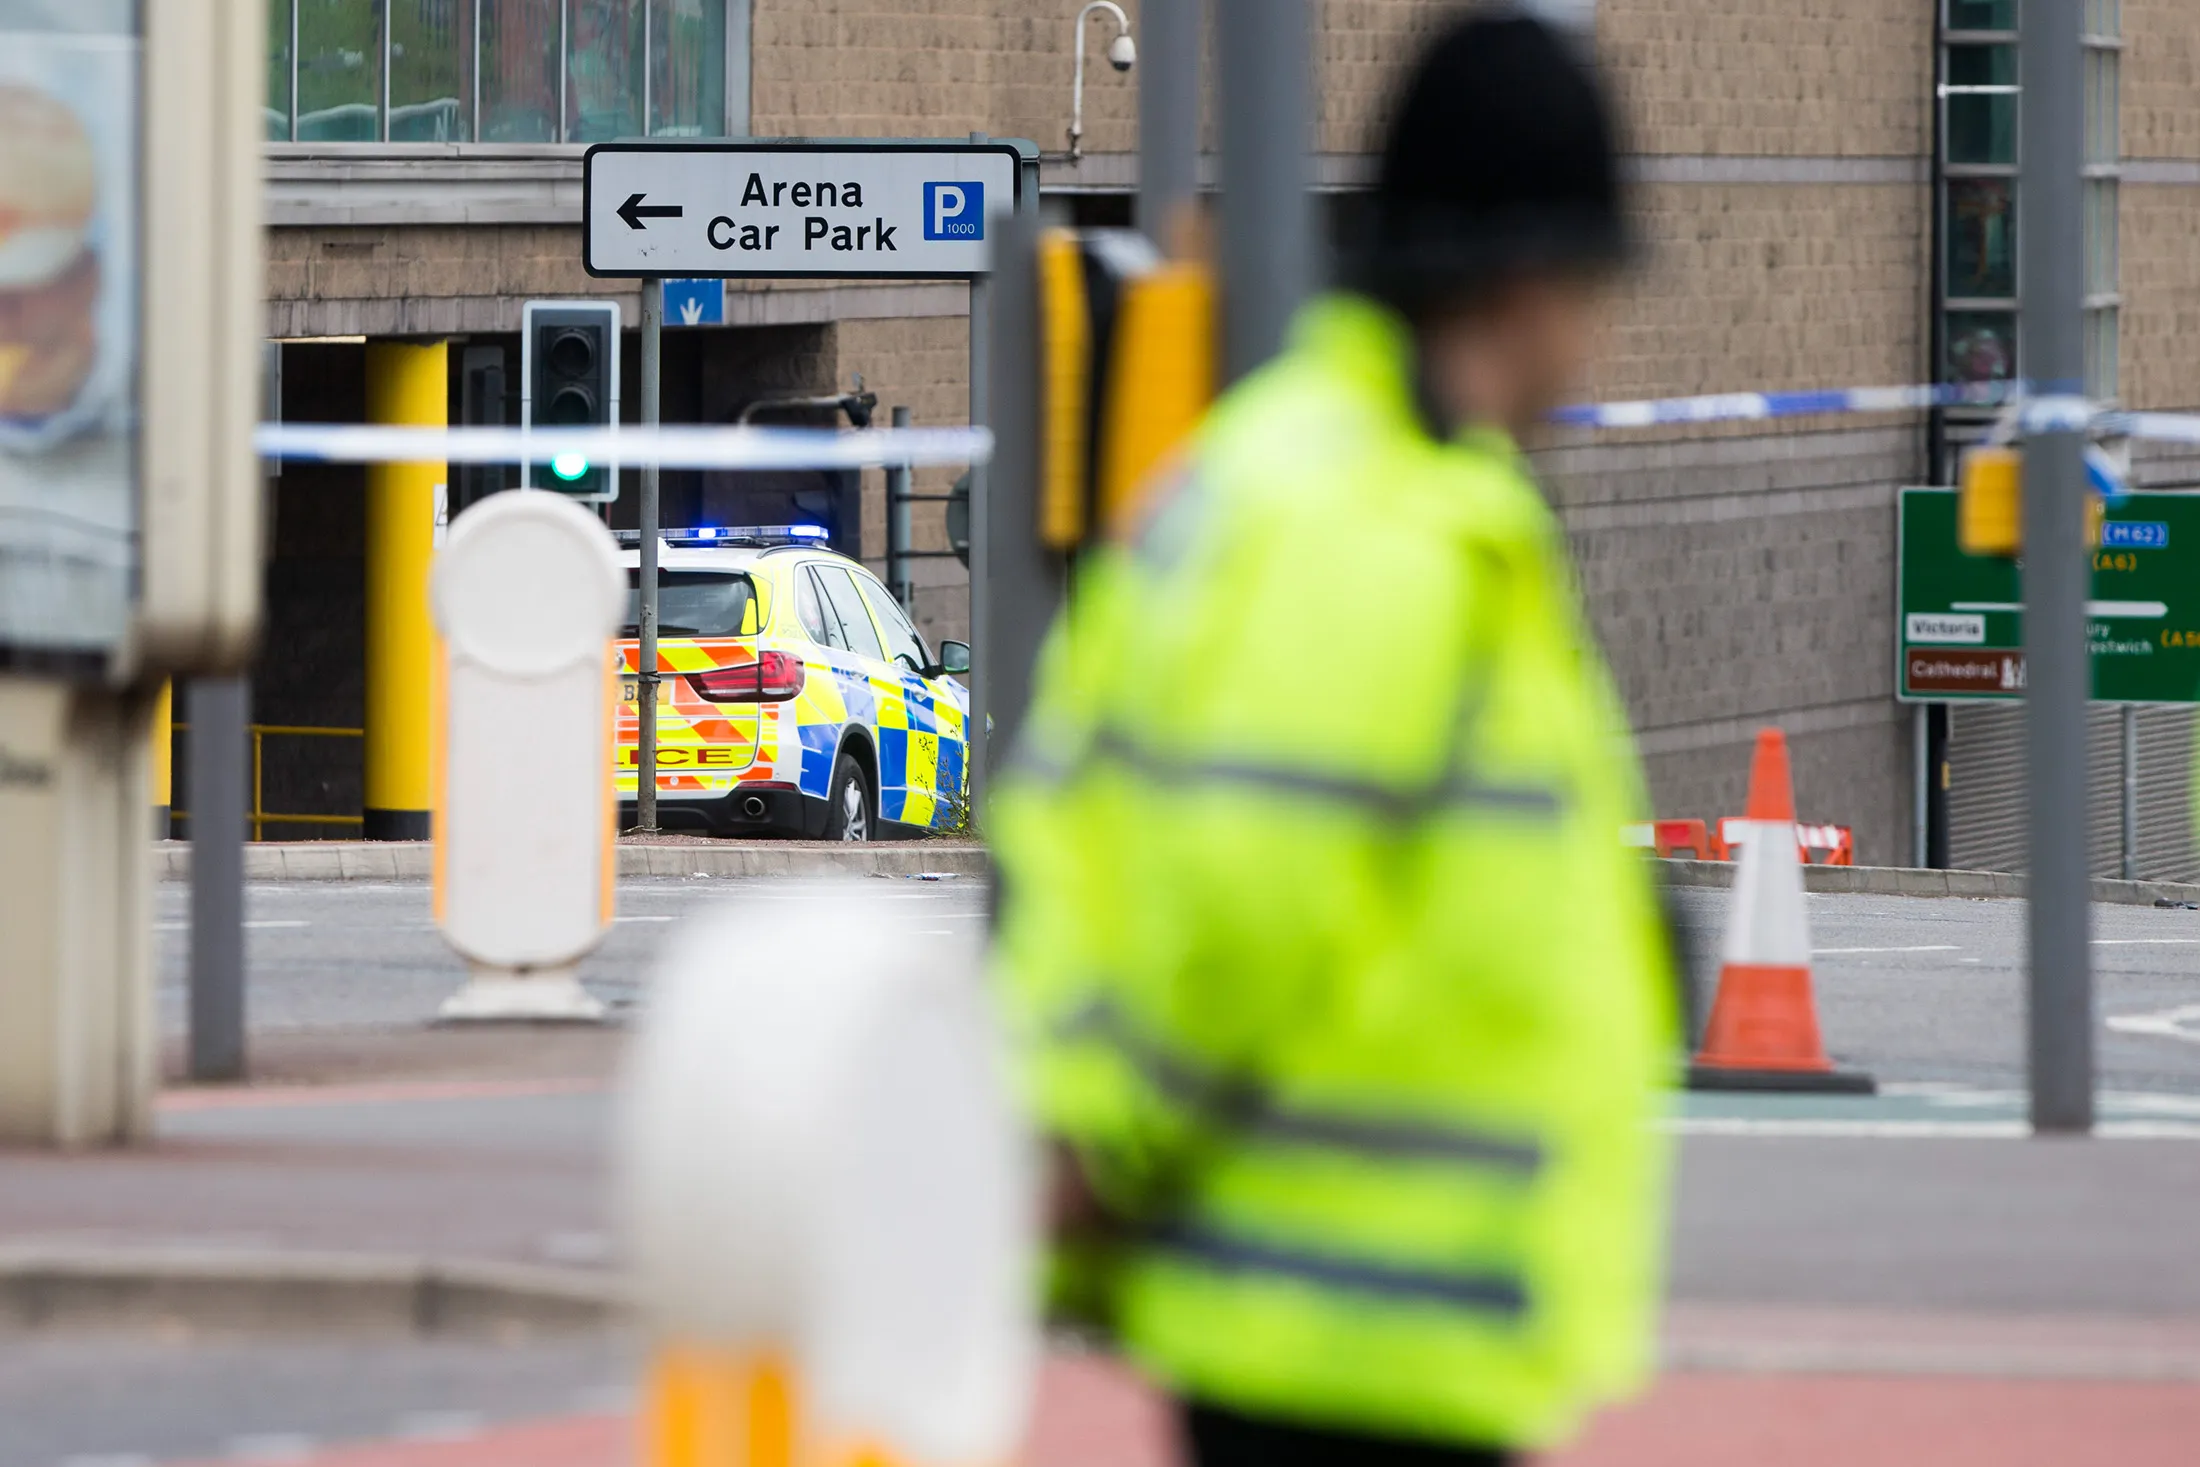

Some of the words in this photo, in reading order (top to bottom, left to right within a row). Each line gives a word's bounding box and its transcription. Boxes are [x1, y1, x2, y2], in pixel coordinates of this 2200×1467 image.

[740, 173, 864, 208] Arena
[934, 185, 966, 234] P
[707, 215, 780, 251] Car
[804, 216, 898, 251] Park
[947, 223, 975, 234] 1000
[2093, 553, 2137, 572] (A6)
[1912, 621, 1980, 635] Victoria
[2085, 624, 2111, 638] ury
[2084, 639, 2154, 655] restwich
[1911, 659, 1998, 678] Cathedral
[615, 748, 733, 765] ICE
